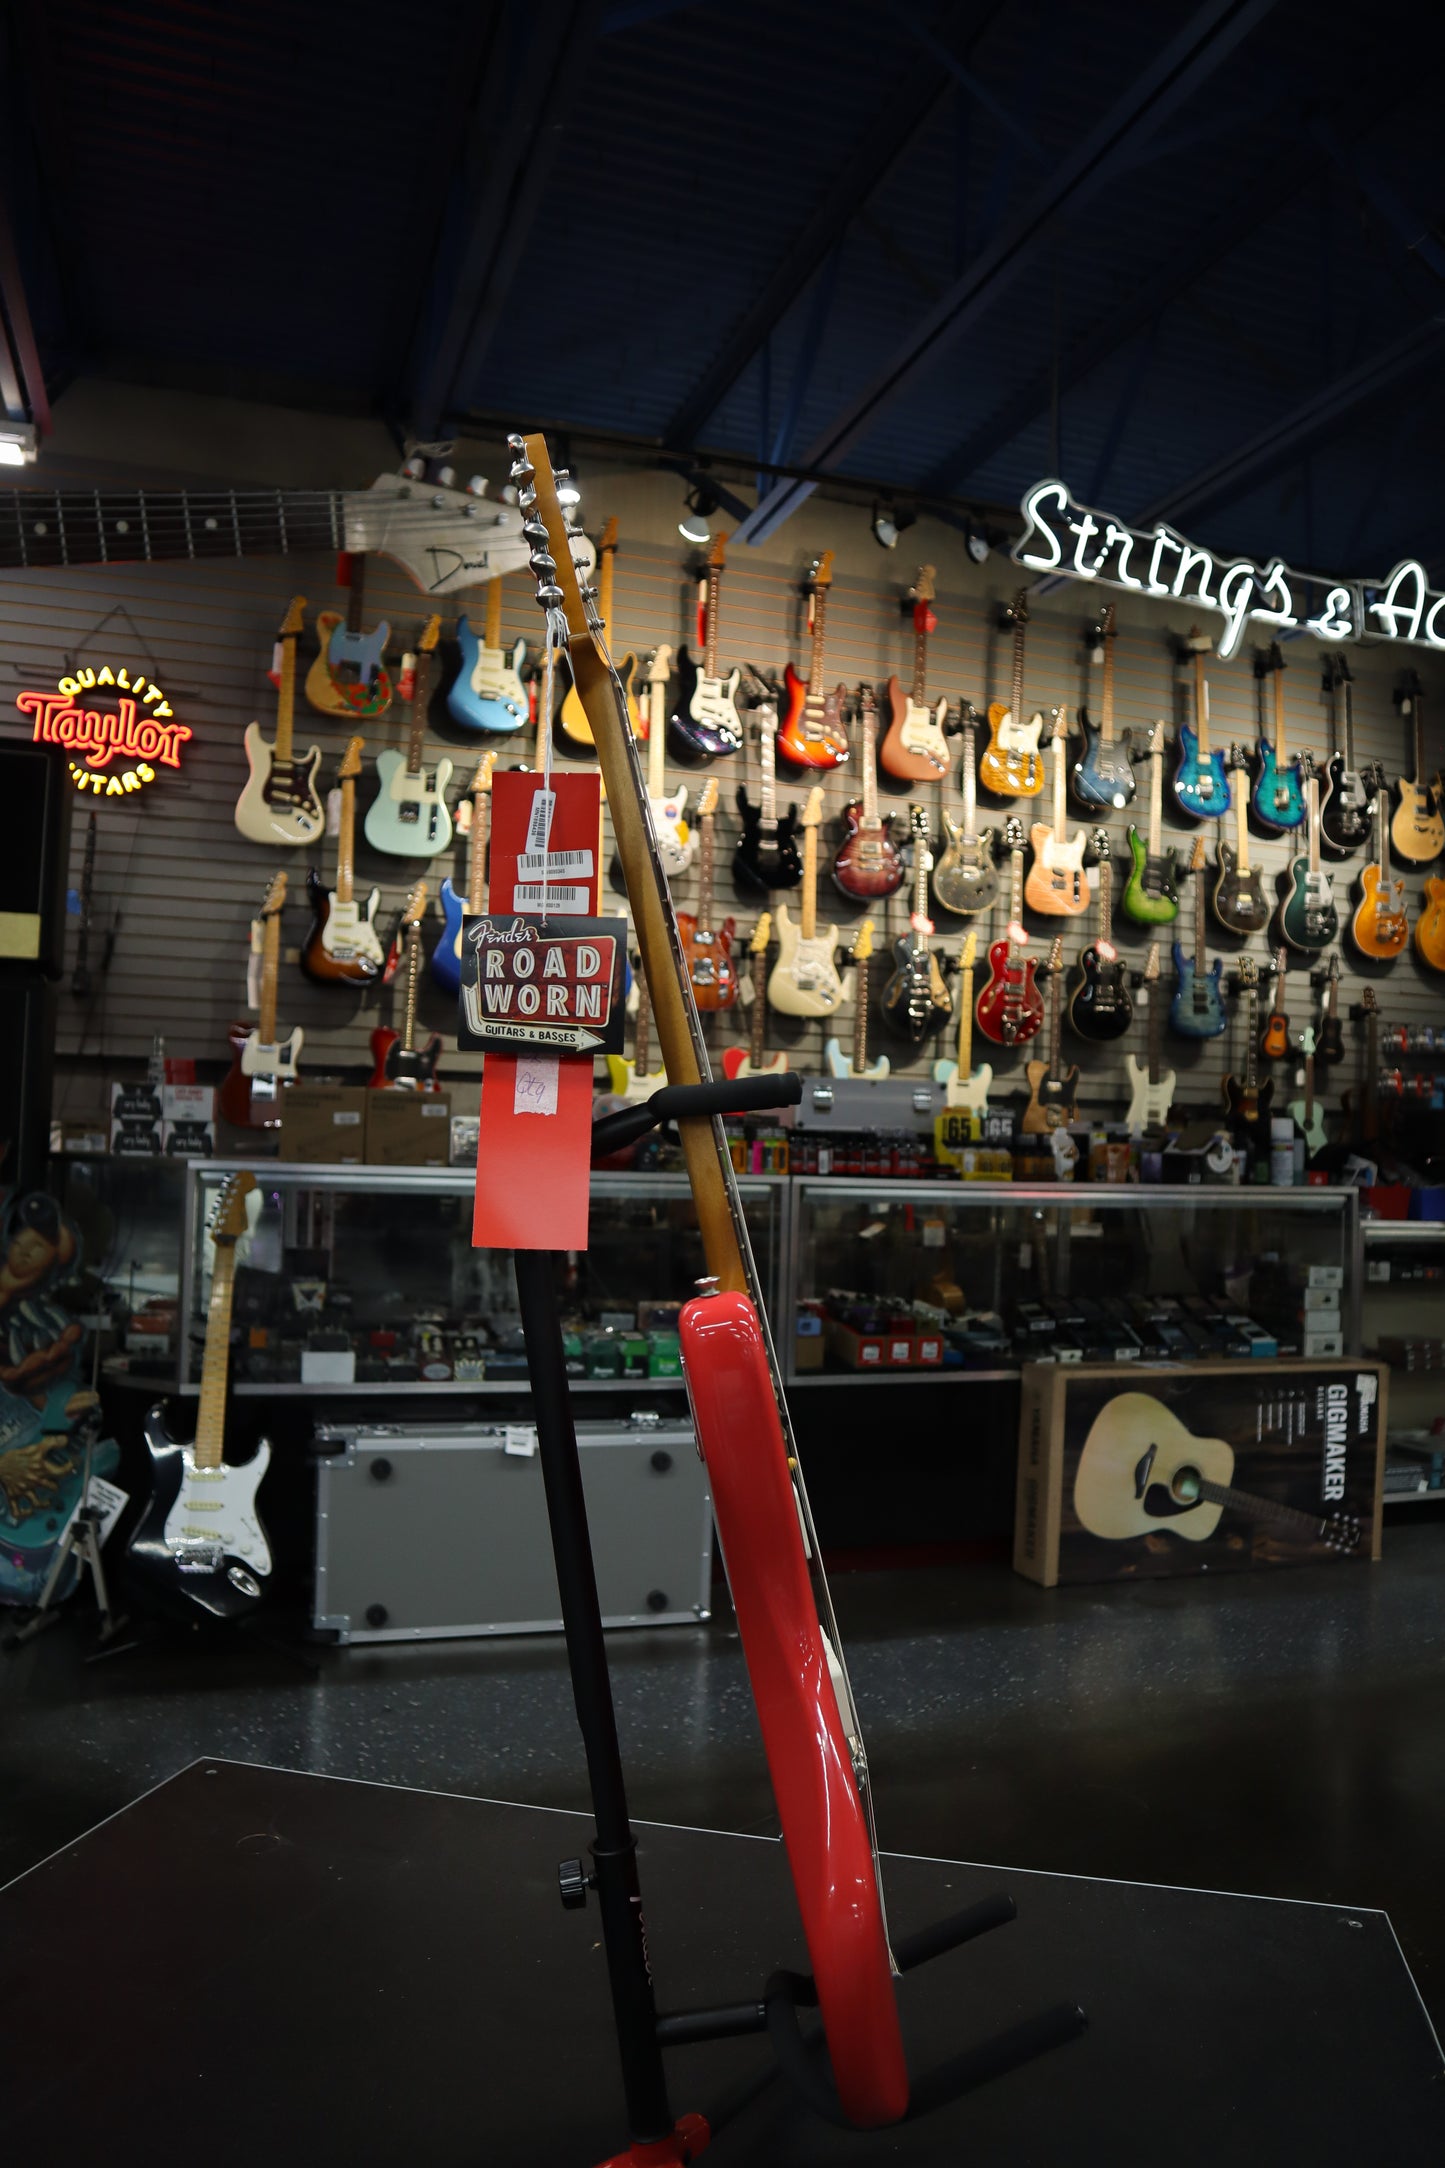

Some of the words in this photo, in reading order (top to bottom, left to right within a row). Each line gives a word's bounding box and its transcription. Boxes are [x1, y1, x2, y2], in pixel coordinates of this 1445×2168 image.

[1022, 484, 1298, 659] Strings
[1307, 587, 1352, 639] &
[58, 666, 173, 717] QUALITY
[16, 691, 193, 768] Taylor
[69, 762, 156, 796] ITARS
[469, 918, 535, 949] Fender
[486, 945, 601, 979] ROAD
[484, 984, 600, 1018] WORN
[485, 1025, 525, 1037] GUITARS
[530, 1030, 535, 1038] &
[538, 1032, 576, 1043] BASSES
[1324, 1384, 1348, 1501] GIGMAKER
